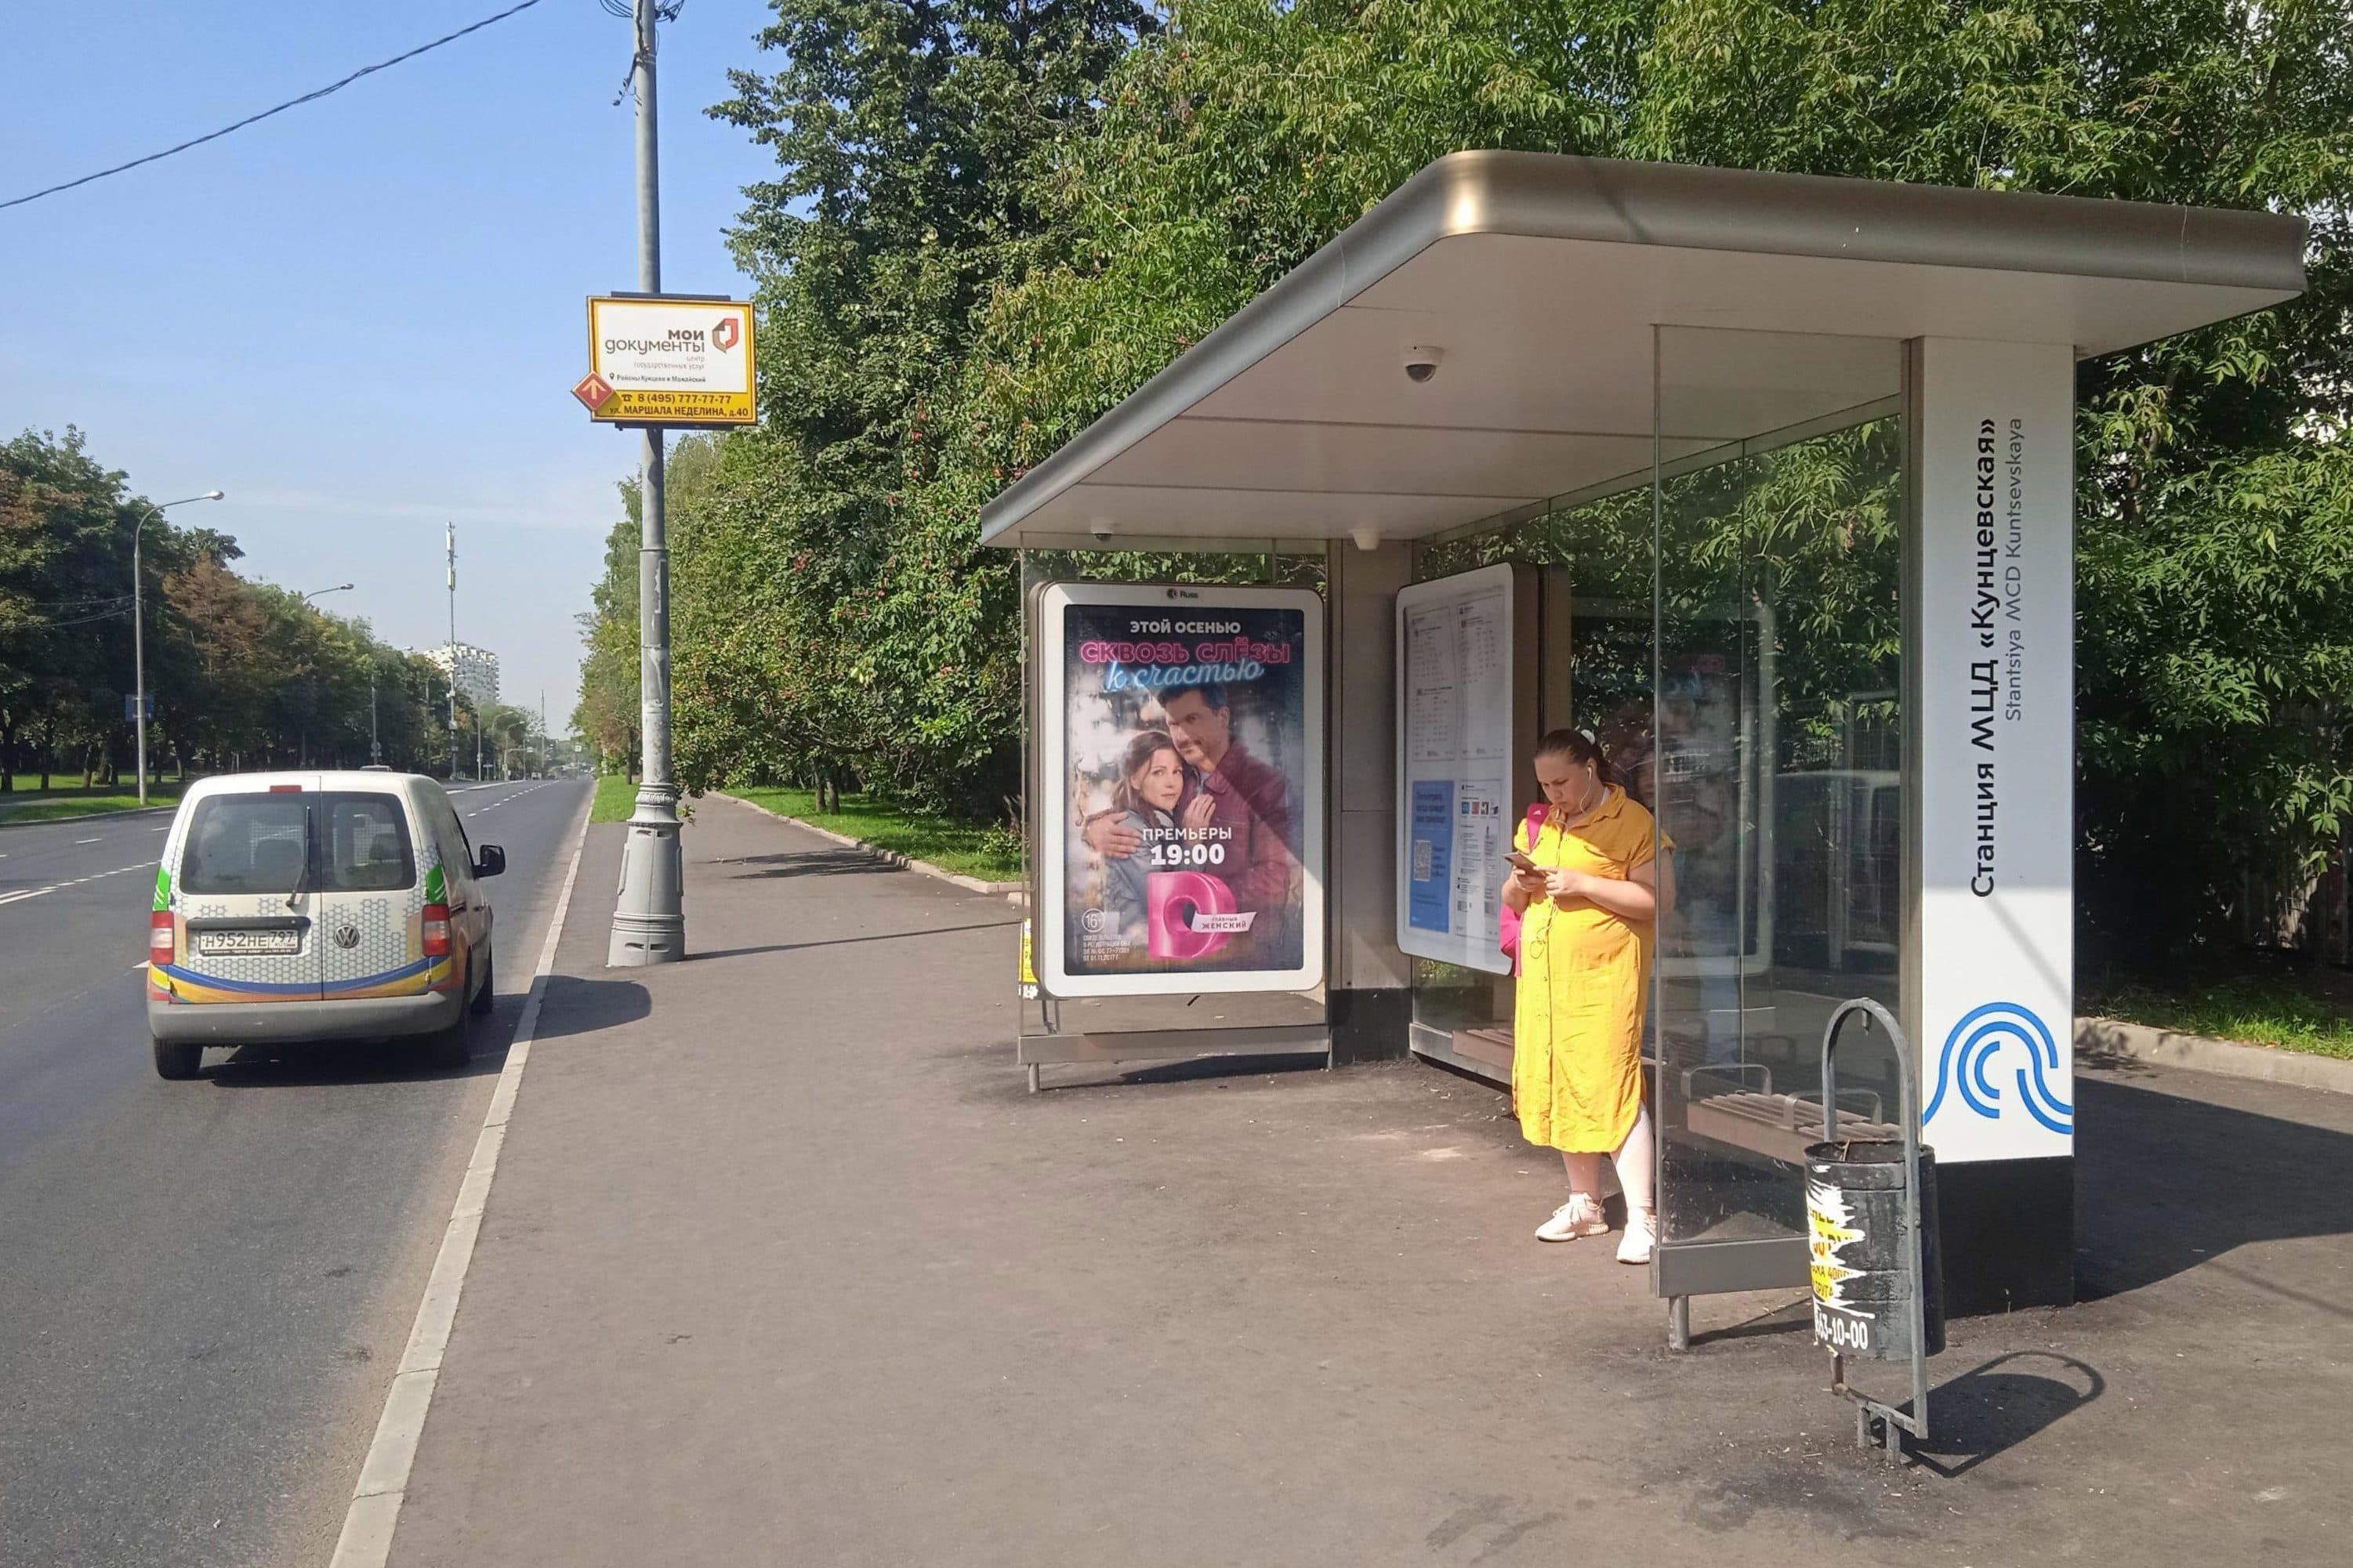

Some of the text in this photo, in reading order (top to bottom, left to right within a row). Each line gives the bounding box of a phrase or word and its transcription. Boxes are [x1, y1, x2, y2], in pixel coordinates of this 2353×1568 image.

[668, 330, 705, 341] мои
[605, 339, 705, 354] документы
[647, 394, 676, 404] (495)
[679, 395, 732, 404] 777-77-77
[624, 406, 672, 415] МАРШАЛА
[674, 407, 727, 417] НЕДЕЛИНА,
[2004, 418, 2025, 722] Stantsiya MCD Kuntsevskaya
[1130, 617, 1242, 634] ЭТОЙ ОСЕНЬЮ
[1079, 636, 1292, 664] СКВОЗЬ СЛЁЗЫ
[1971, 418, 2000, 898] Станция МЦД «Кунцевская»
[1133, 658, 1265, 687] счастью
[1143, 827, 1232, 841] ПРЕМЬЕРЫ
[1150, 843, 1225, 866] 19:00
[205, 931, 294, 947] Н952НЕ 797
